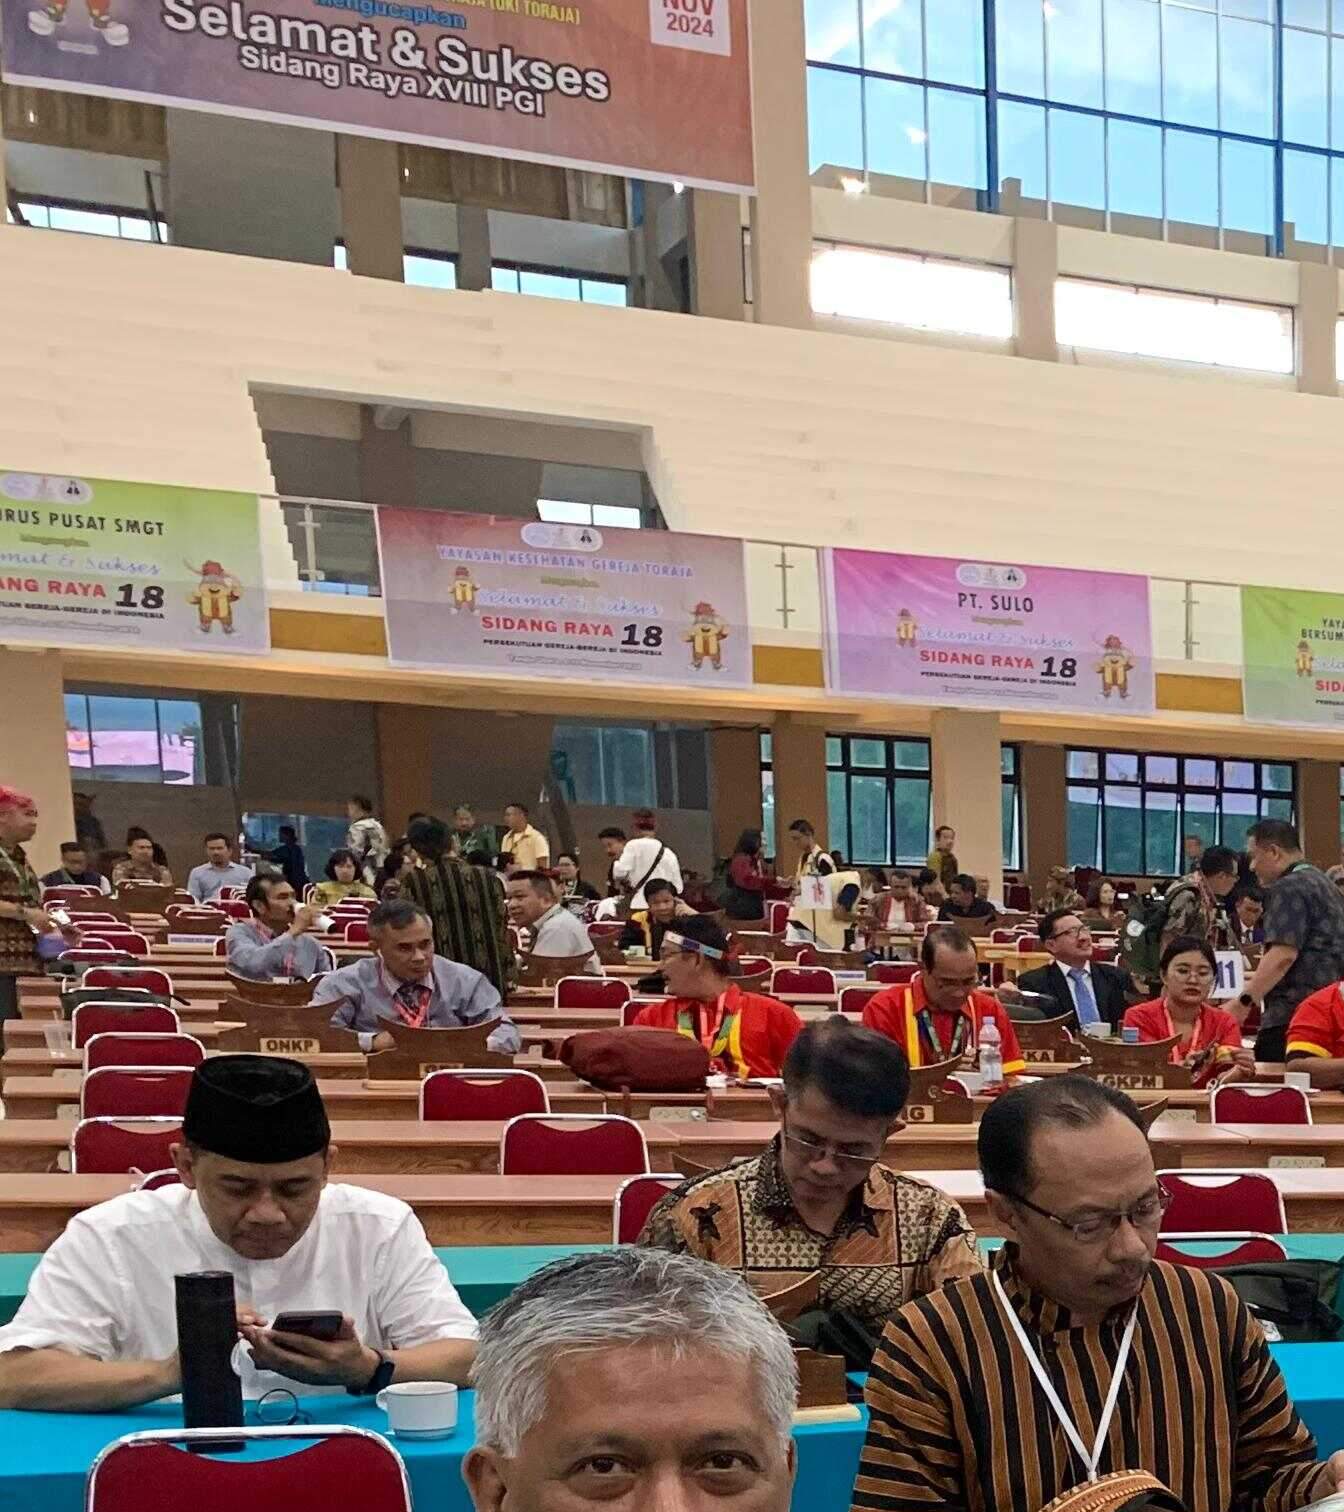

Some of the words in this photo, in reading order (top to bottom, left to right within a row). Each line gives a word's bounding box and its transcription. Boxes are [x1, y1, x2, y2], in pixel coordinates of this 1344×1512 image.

[666, 13, 714, 37] 2024
[163, 0, 379, 62] Selamat
[391, 28, 427, 70] &
[438, 35, 611, 102] Sukses
[240, 45, 341, 88] Sidang
[349, 62, 418, 97] Raya
[426, 75, 488, 106] XVIII
[495, 87, 544, 116] PGI
[48, 511, 106, 532] PUSAT
[115, 518, 165, 537] SMGT
[48, 580, 107, 599] RAYA
[115, 583, 165, 609] 18
[957, 592, 984, 610] PT.
[990, 595, 1035, 613] SULO
[481, 615, 558, 634] SIDANG
[563, 619, 615, 638] RAYA
[620, 623, 664, 648] 18
[919, 649, 986, 667] SIDANG
[991, 654, 1036, 670] RAYA
[1039, 655, 1078, 679] 18
[266, 1038, 314, 1052] ONKP
